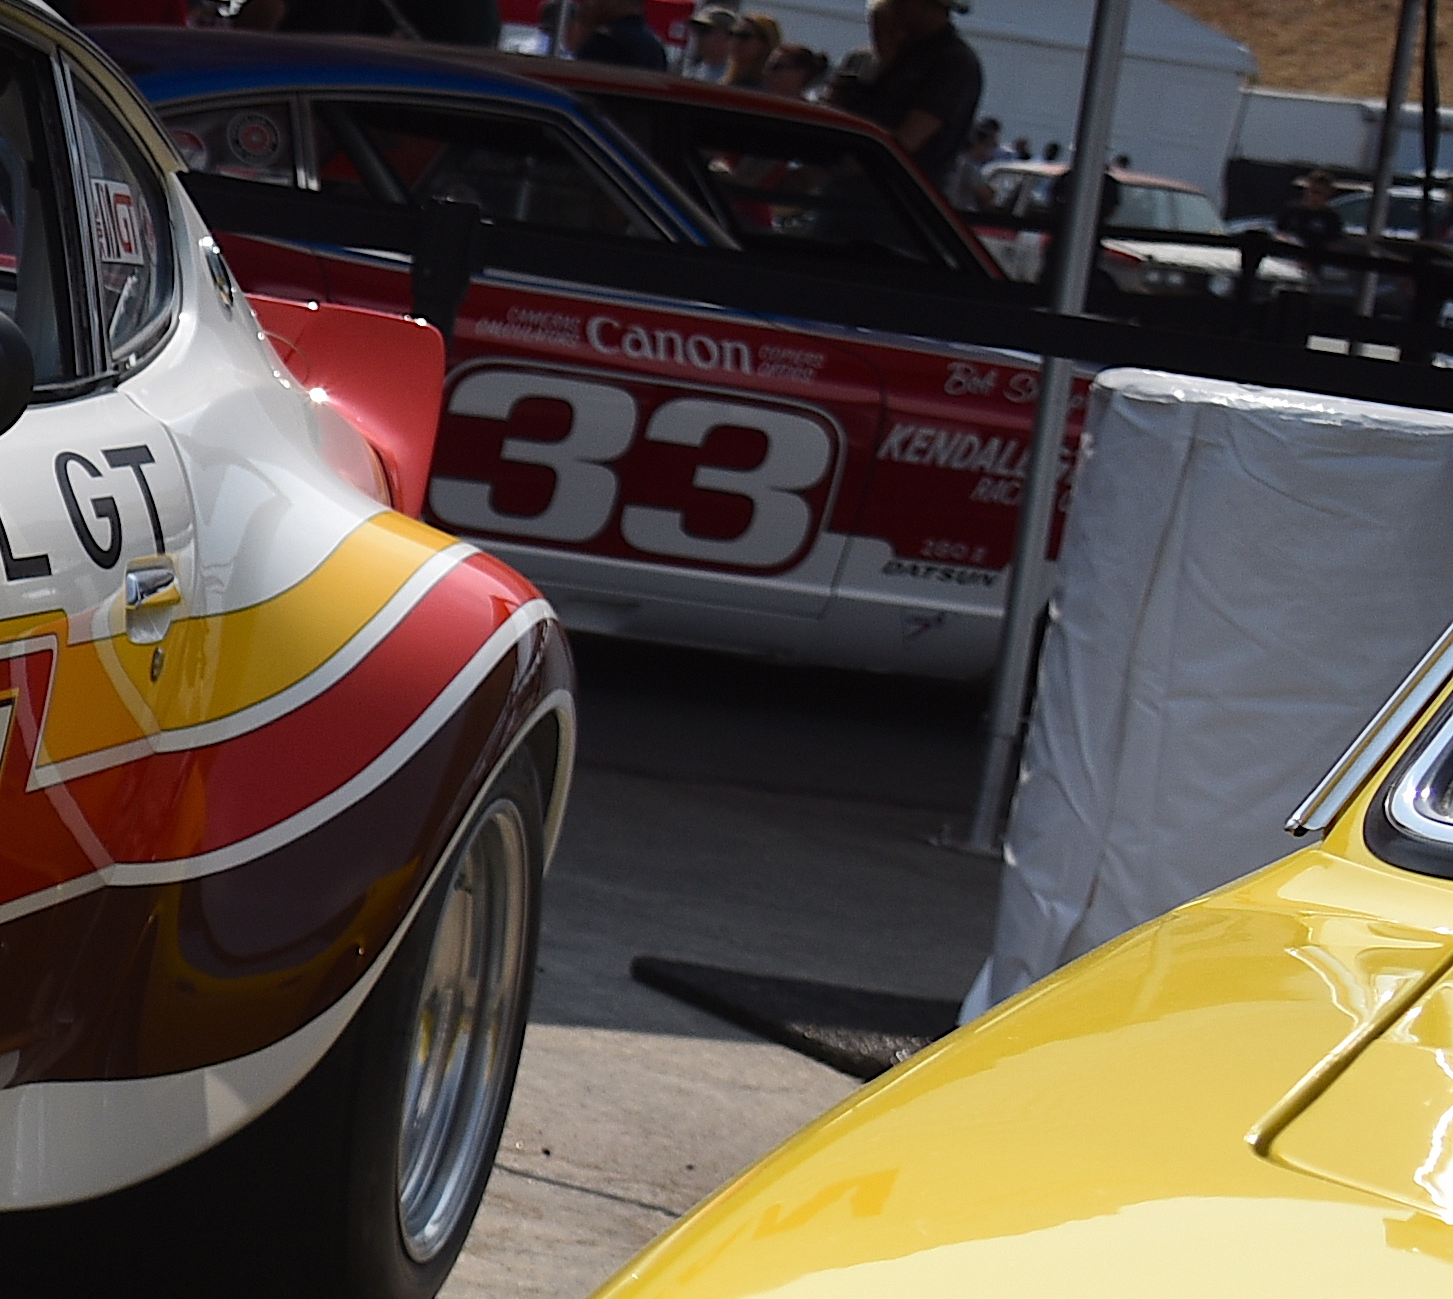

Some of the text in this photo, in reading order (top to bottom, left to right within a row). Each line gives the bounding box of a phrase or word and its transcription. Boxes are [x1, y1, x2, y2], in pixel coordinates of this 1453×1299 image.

[585, 315, 753, 376] Canon
[54, 444, 166, 569] GT
[429, 370, 832, 568] 33
